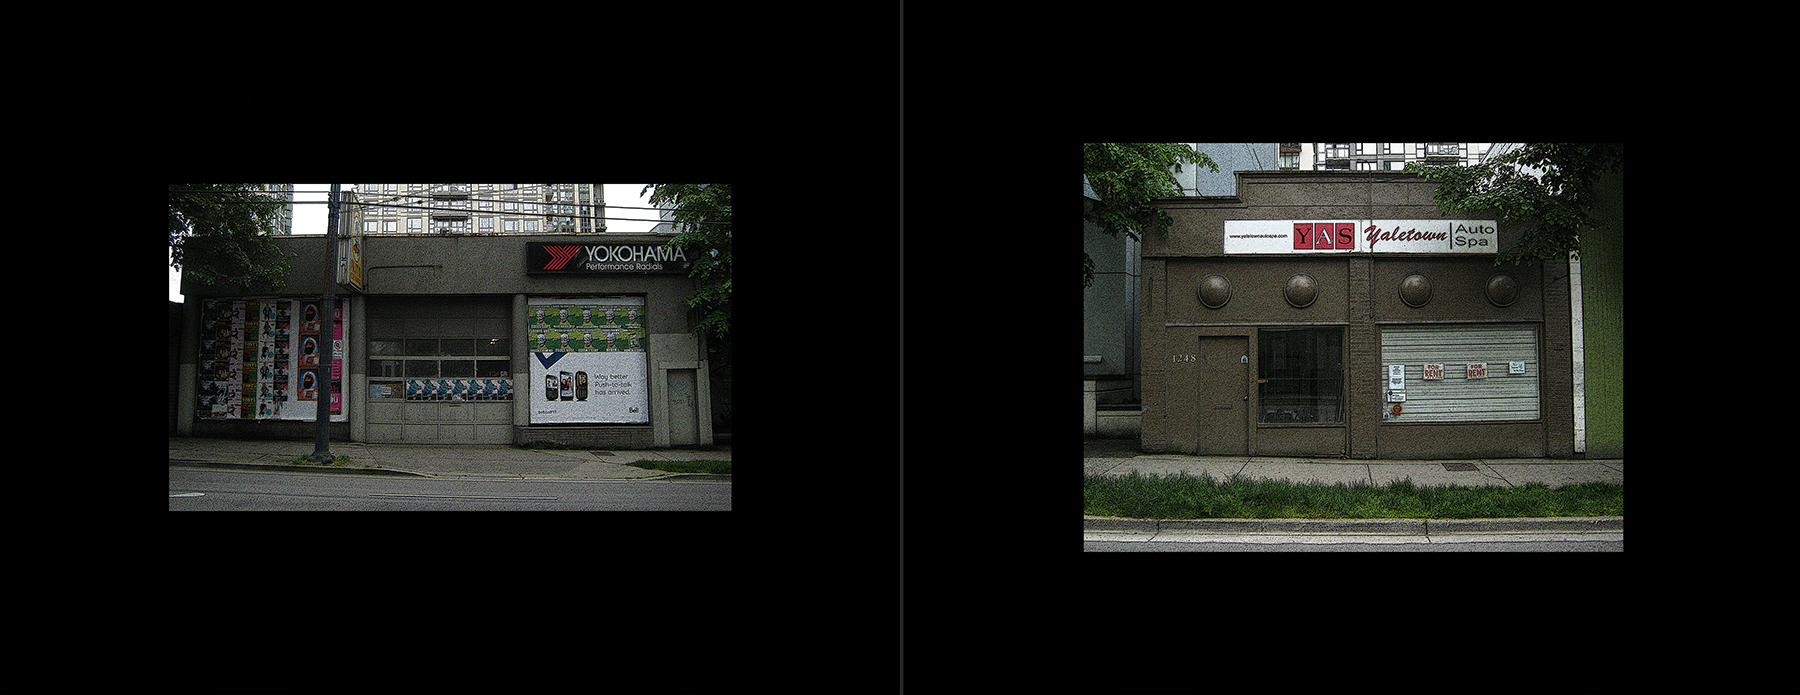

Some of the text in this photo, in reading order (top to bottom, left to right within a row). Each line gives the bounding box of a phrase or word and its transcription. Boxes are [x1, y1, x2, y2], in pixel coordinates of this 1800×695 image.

[1454, 224, 1495, 235] Auto
[1295, 227, 1353, 246] YAS
[1364, 225, 1448, 249] Yaletown
[1455, 236, 1489, 247] Spa
[585, 245, 687, 262] YOKOHAMA
[586, 262, 663, 271] Performance Radials
[1172, 354, 1197, 363] 1248
[1468, 369, 1486, 377] RENT
